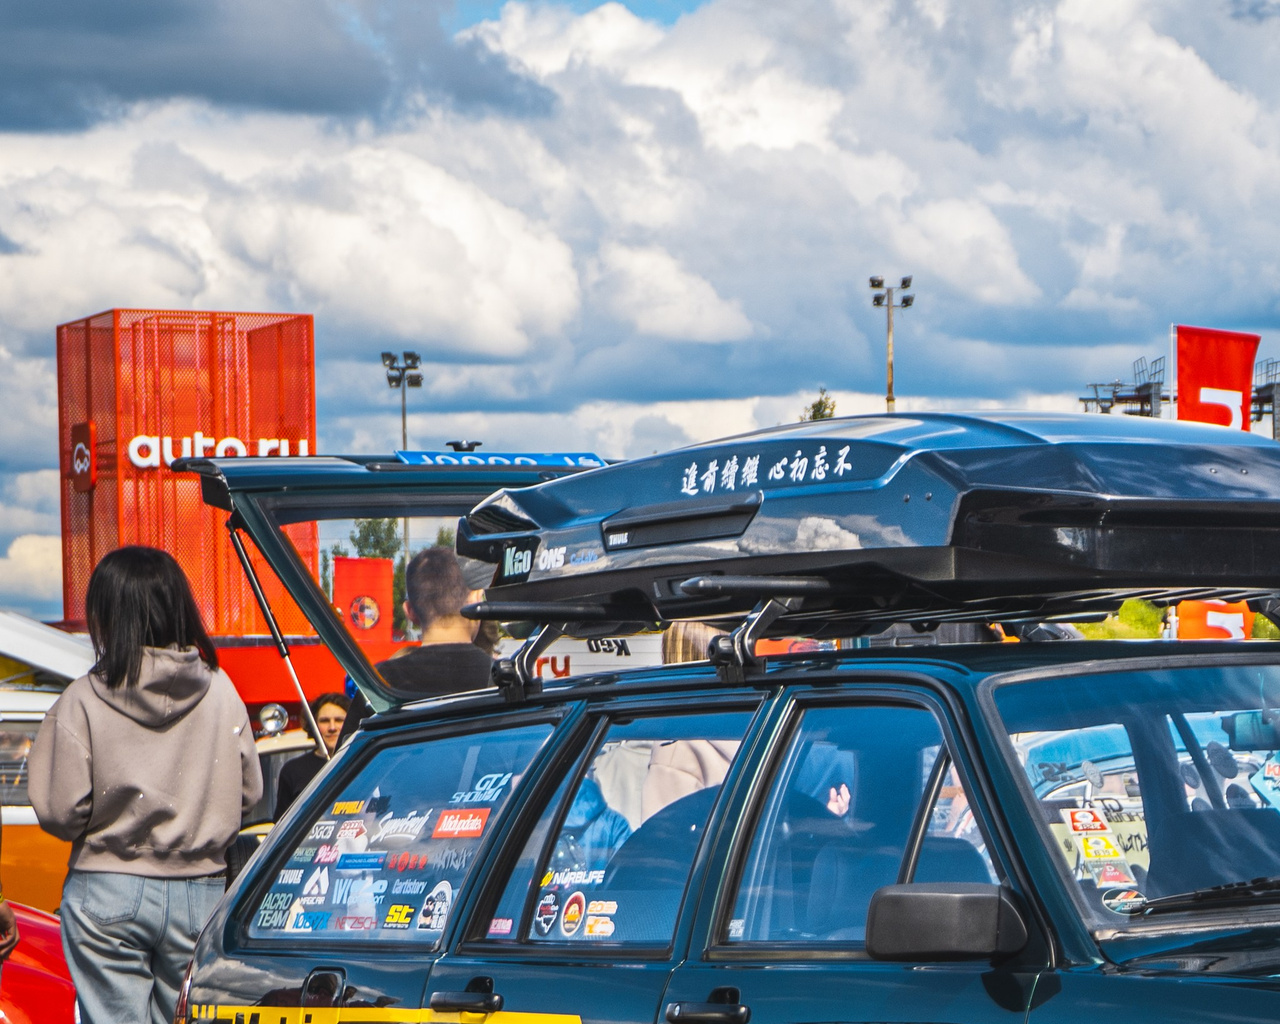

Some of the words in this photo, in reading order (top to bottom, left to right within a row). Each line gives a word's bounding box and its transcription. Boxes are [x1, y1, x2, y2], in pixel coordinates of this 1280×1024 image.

[128, 431, 310, 467] autoru
[609, 532, 629, 546] THULE
[278, 869, 304, 884] THULE
[258, 910, 290, 927] TEAM
